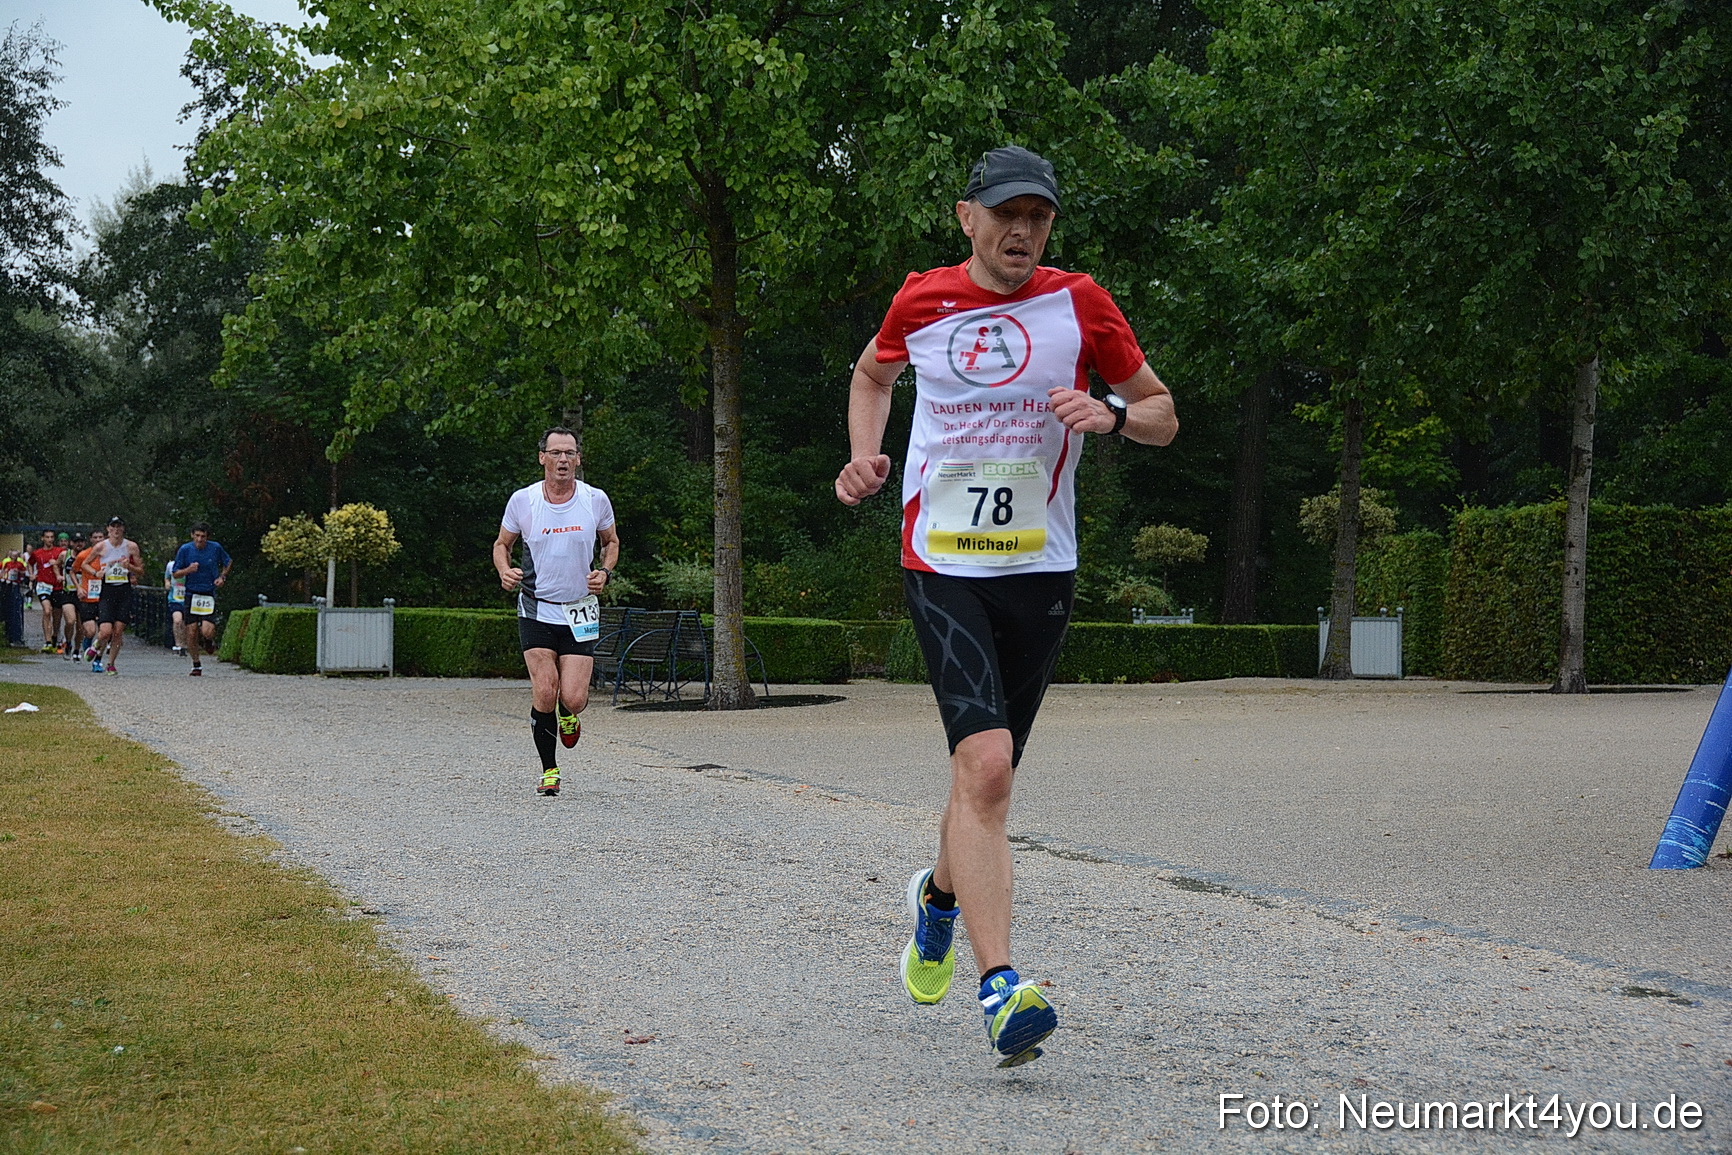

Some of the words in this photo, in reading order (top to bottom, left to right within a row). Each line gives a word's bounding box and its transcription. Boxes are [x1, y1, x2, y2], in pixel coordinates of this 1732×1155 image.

[1022, 398, 1052, 412] HER
[943, 421, 957, 431] Dr.
[959, 419, 984, 429] Heck
[993, 419, 1008, 429] Dr.
[1011, 418, 1046, 429] Röschl
[942, 432, 1043, 445] Leistungsdiagnostik
[982, 462, 1038, 476] BOCK
[967, 487, 1013, 526] 78
[552, 525, 583, 534] KLEBL
[957, 535, 1019, 551] Michael
[196, 599, 211, 607] 615
